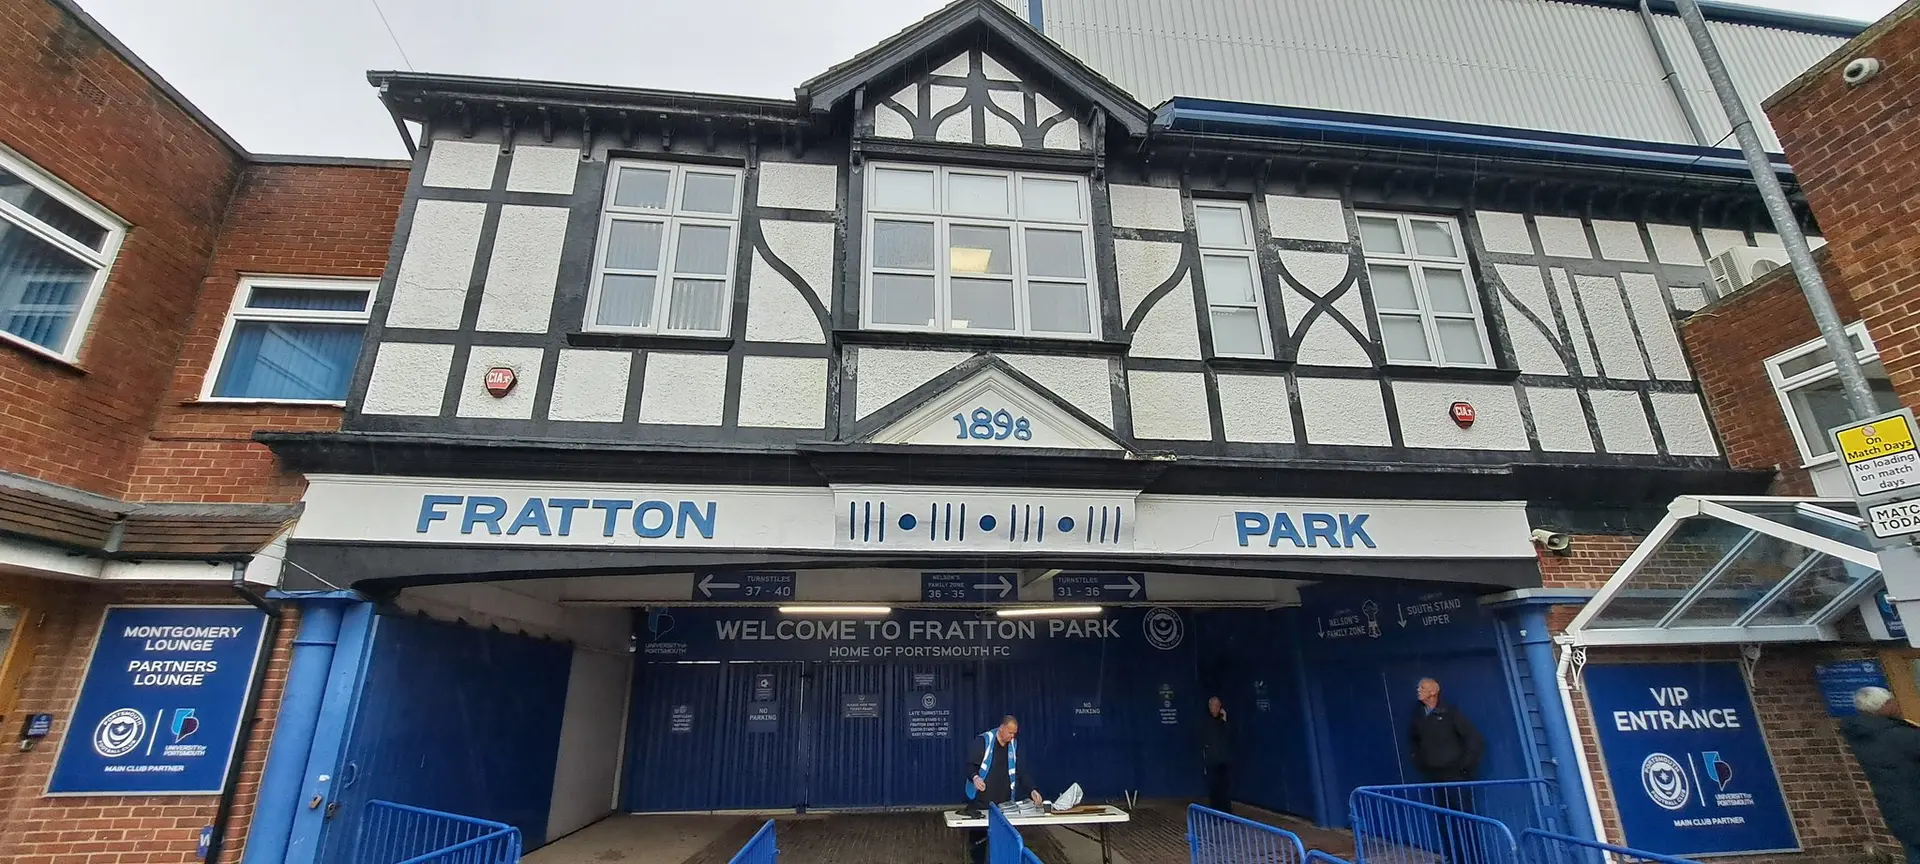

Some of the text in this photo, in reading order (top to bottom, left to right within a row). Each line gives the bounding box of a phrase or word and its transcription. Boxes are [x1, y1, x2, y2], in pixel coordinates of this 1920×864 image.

[952, 408, 1033, 442] 1898
[1865, 436, 1882, 446] On
[1848, 438, 1912, 460] Match Days
[1855, 453, 1916, 473] No loading
[1861, 465, 1913, 482] on match
[1879, 478, 1906, 490] days
[416, 494, 1377, 549] FRATTON PARK
[746, 575, 791, 583] TURNSTILES
[1057, 576, 1098, 584] TURNSTILES
[745, 586, 761, 597] 37
[773, 586, 791, 597] 40
[928, 589, 942, 599] 36
[951, 589, 965, 599] 35
[1057, 586, 1073, 597] 31
[1084, 586, 1100, 597] 36
[1406, 598, 1462, 616] SOUTH STAND
[1421, 614, 1451, 626] UPPER
[124, 626, 243, 639] MONTGOMERY
[716, 618, 1121, 641] WELCOME TO FRATTON PARK
[144, 640, 214, 651] LOUNGE
[829, 646, 1011, 657] HOME OF PORTSMOUTH FC
[127, 660, 218, 673] PARTNERS
[133, 674, 204, 686] LOUNGE
[1649, 686, 1689, 707] VIP
[103, 710, 143, 726] PORTSMOUTH
[1613, 708, 1740, 731] ENTRANCE
[1644, 755, 1680, 774] PORTSMOUTH
[1716, 799, 1754, 807] PORTSMOUTH
[1673, 816, 1745, 827] MAIN CLUB PARTNER
